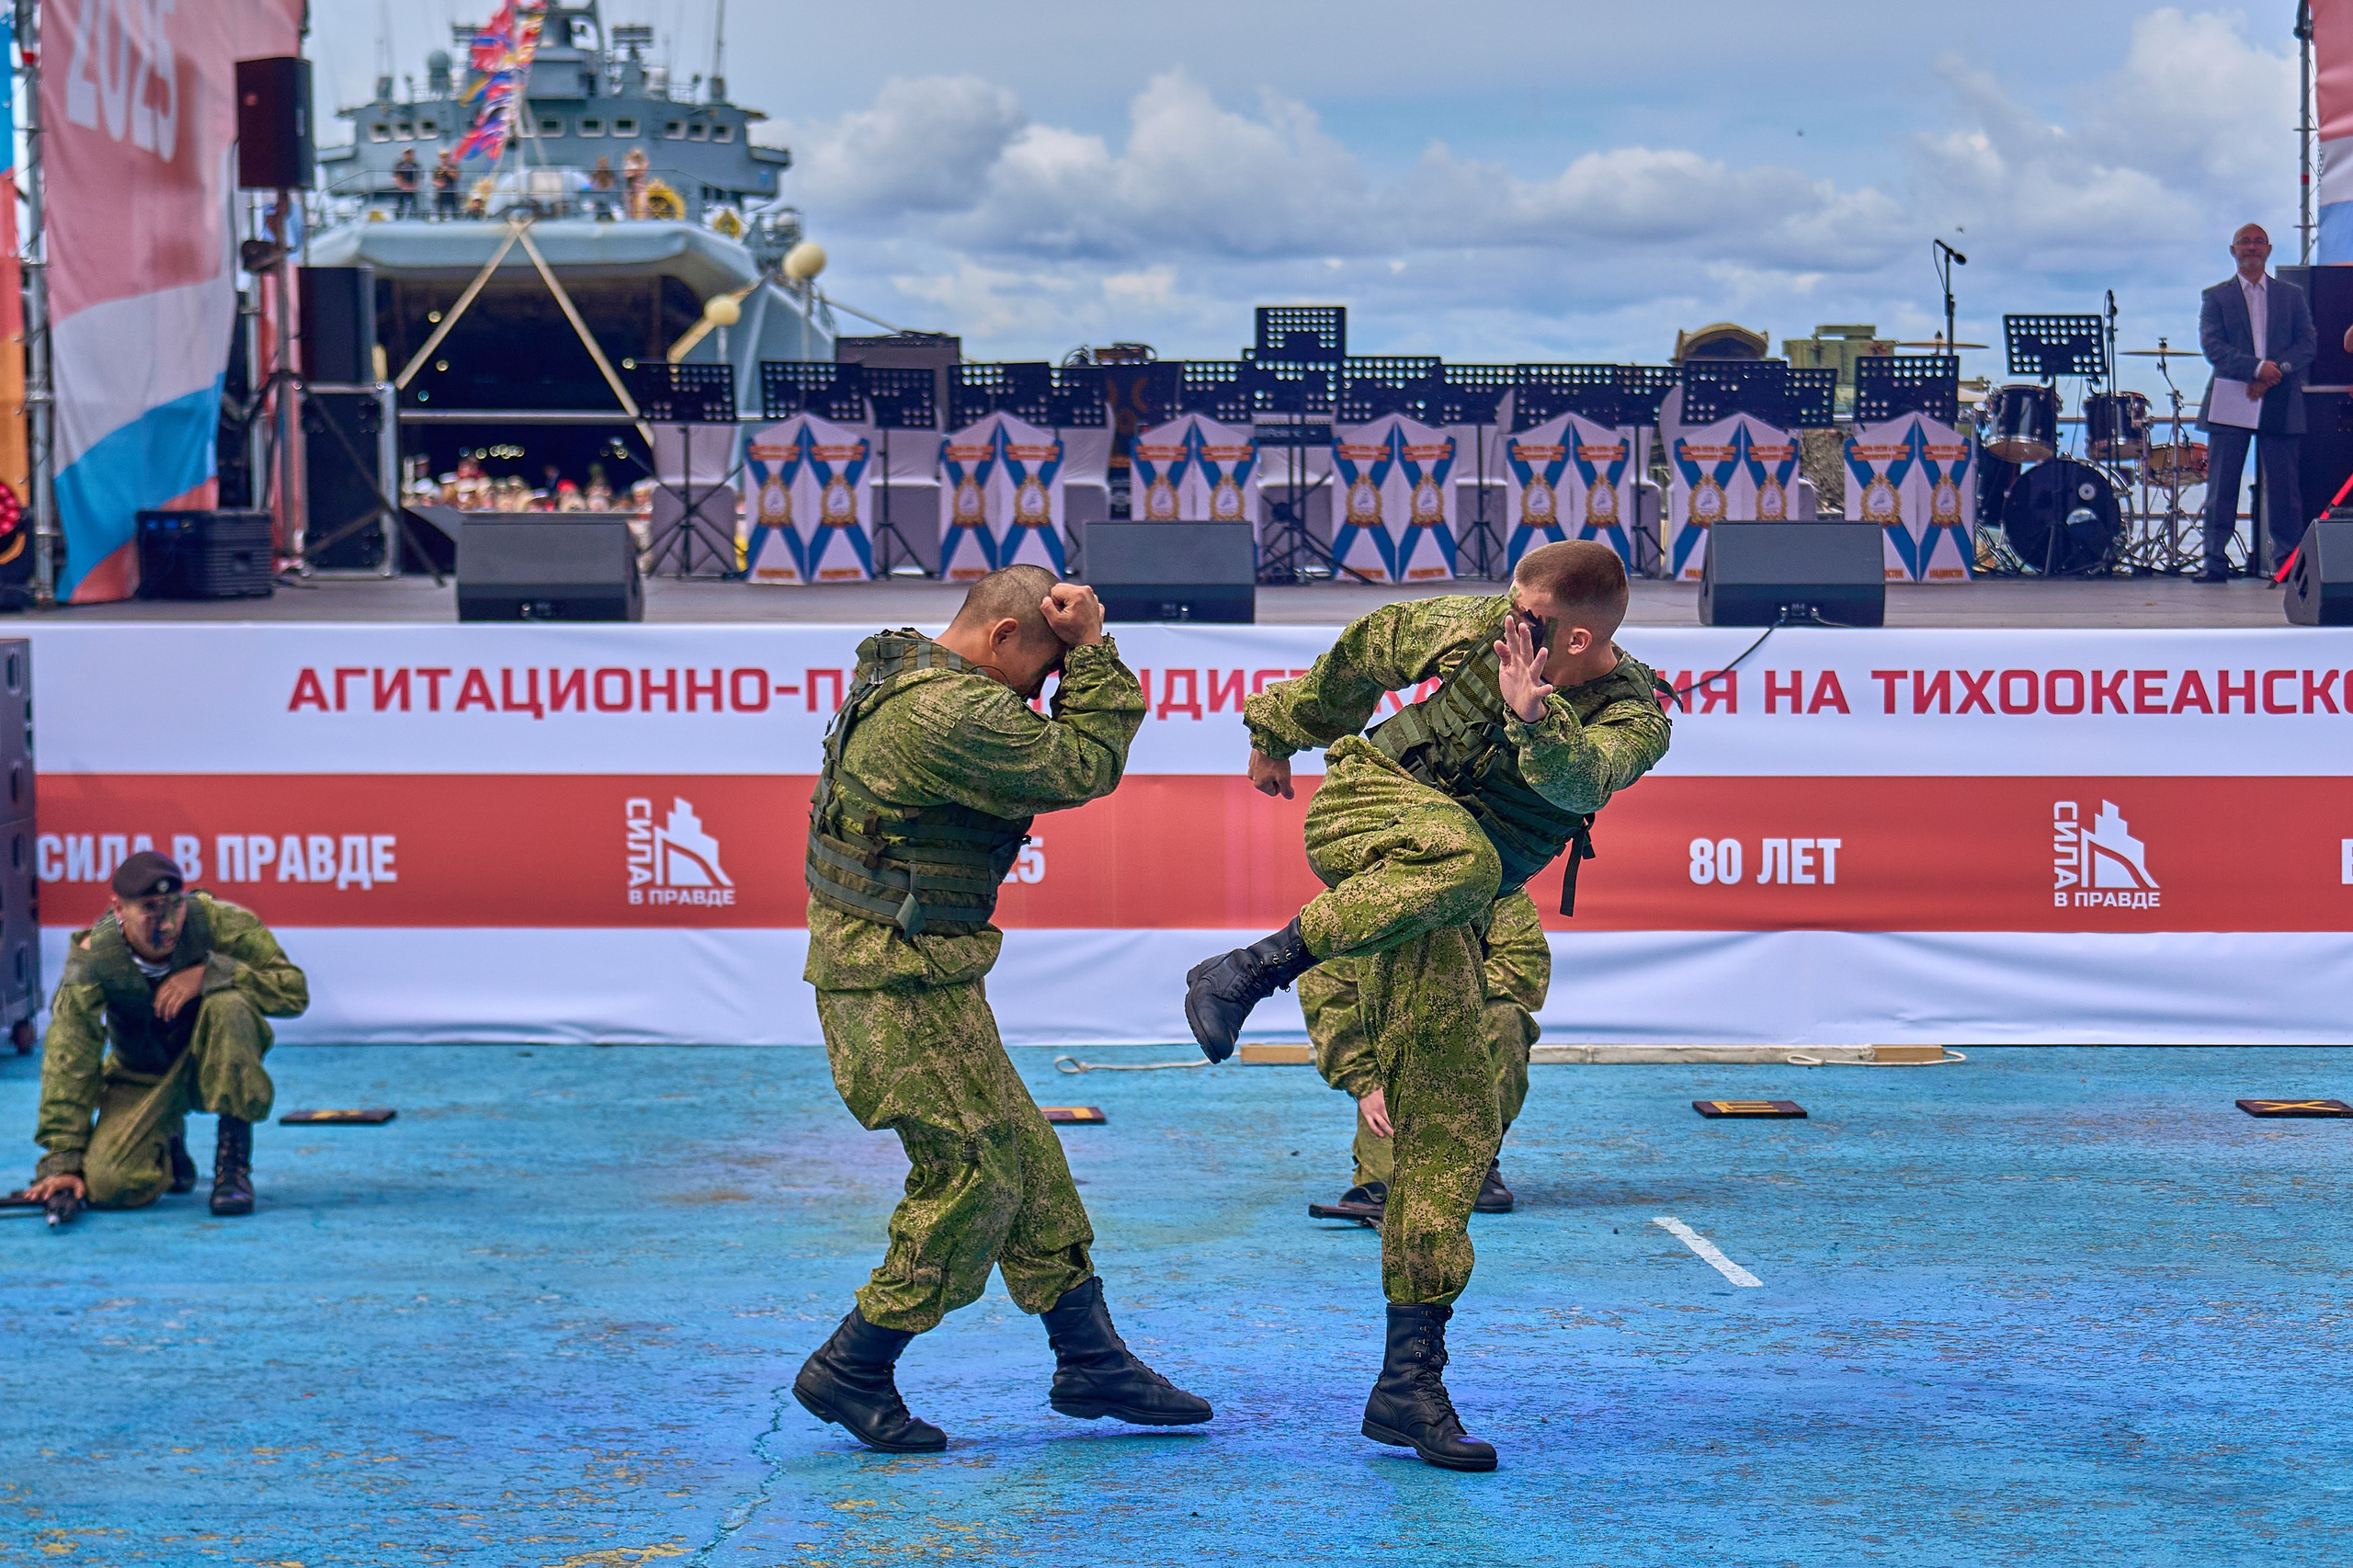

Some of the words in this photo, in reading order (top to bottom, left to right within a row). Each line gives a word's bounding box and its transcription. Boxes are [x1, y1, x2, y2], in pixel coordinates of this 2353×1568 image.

[66, 0, 177, 163] 2025
[288, 667, 856, 720] АГИТАЦИОННО-П
[1764, 670, 1851, 714] НА
[1870, 669, 2353, 714] ТИХООКЕАНСК
[172, 834, 202, 882] В
[216, 834, 397, 891] ПРАВДЕ
[626, 798, 653, 888] СИЛА
[1688, 837, 1743, 885] 80
[1756, 838, 1842, 884] ЛЕТ
[2053, 801, 2078, 890] СИЛА
[629, 889, 643, 905] В
[649, 889, 735, 907] ПРАВДЕ
[2053, 892, 2068, 907] В
[2075, 892, 2161, 910] ПРАВДЕ
